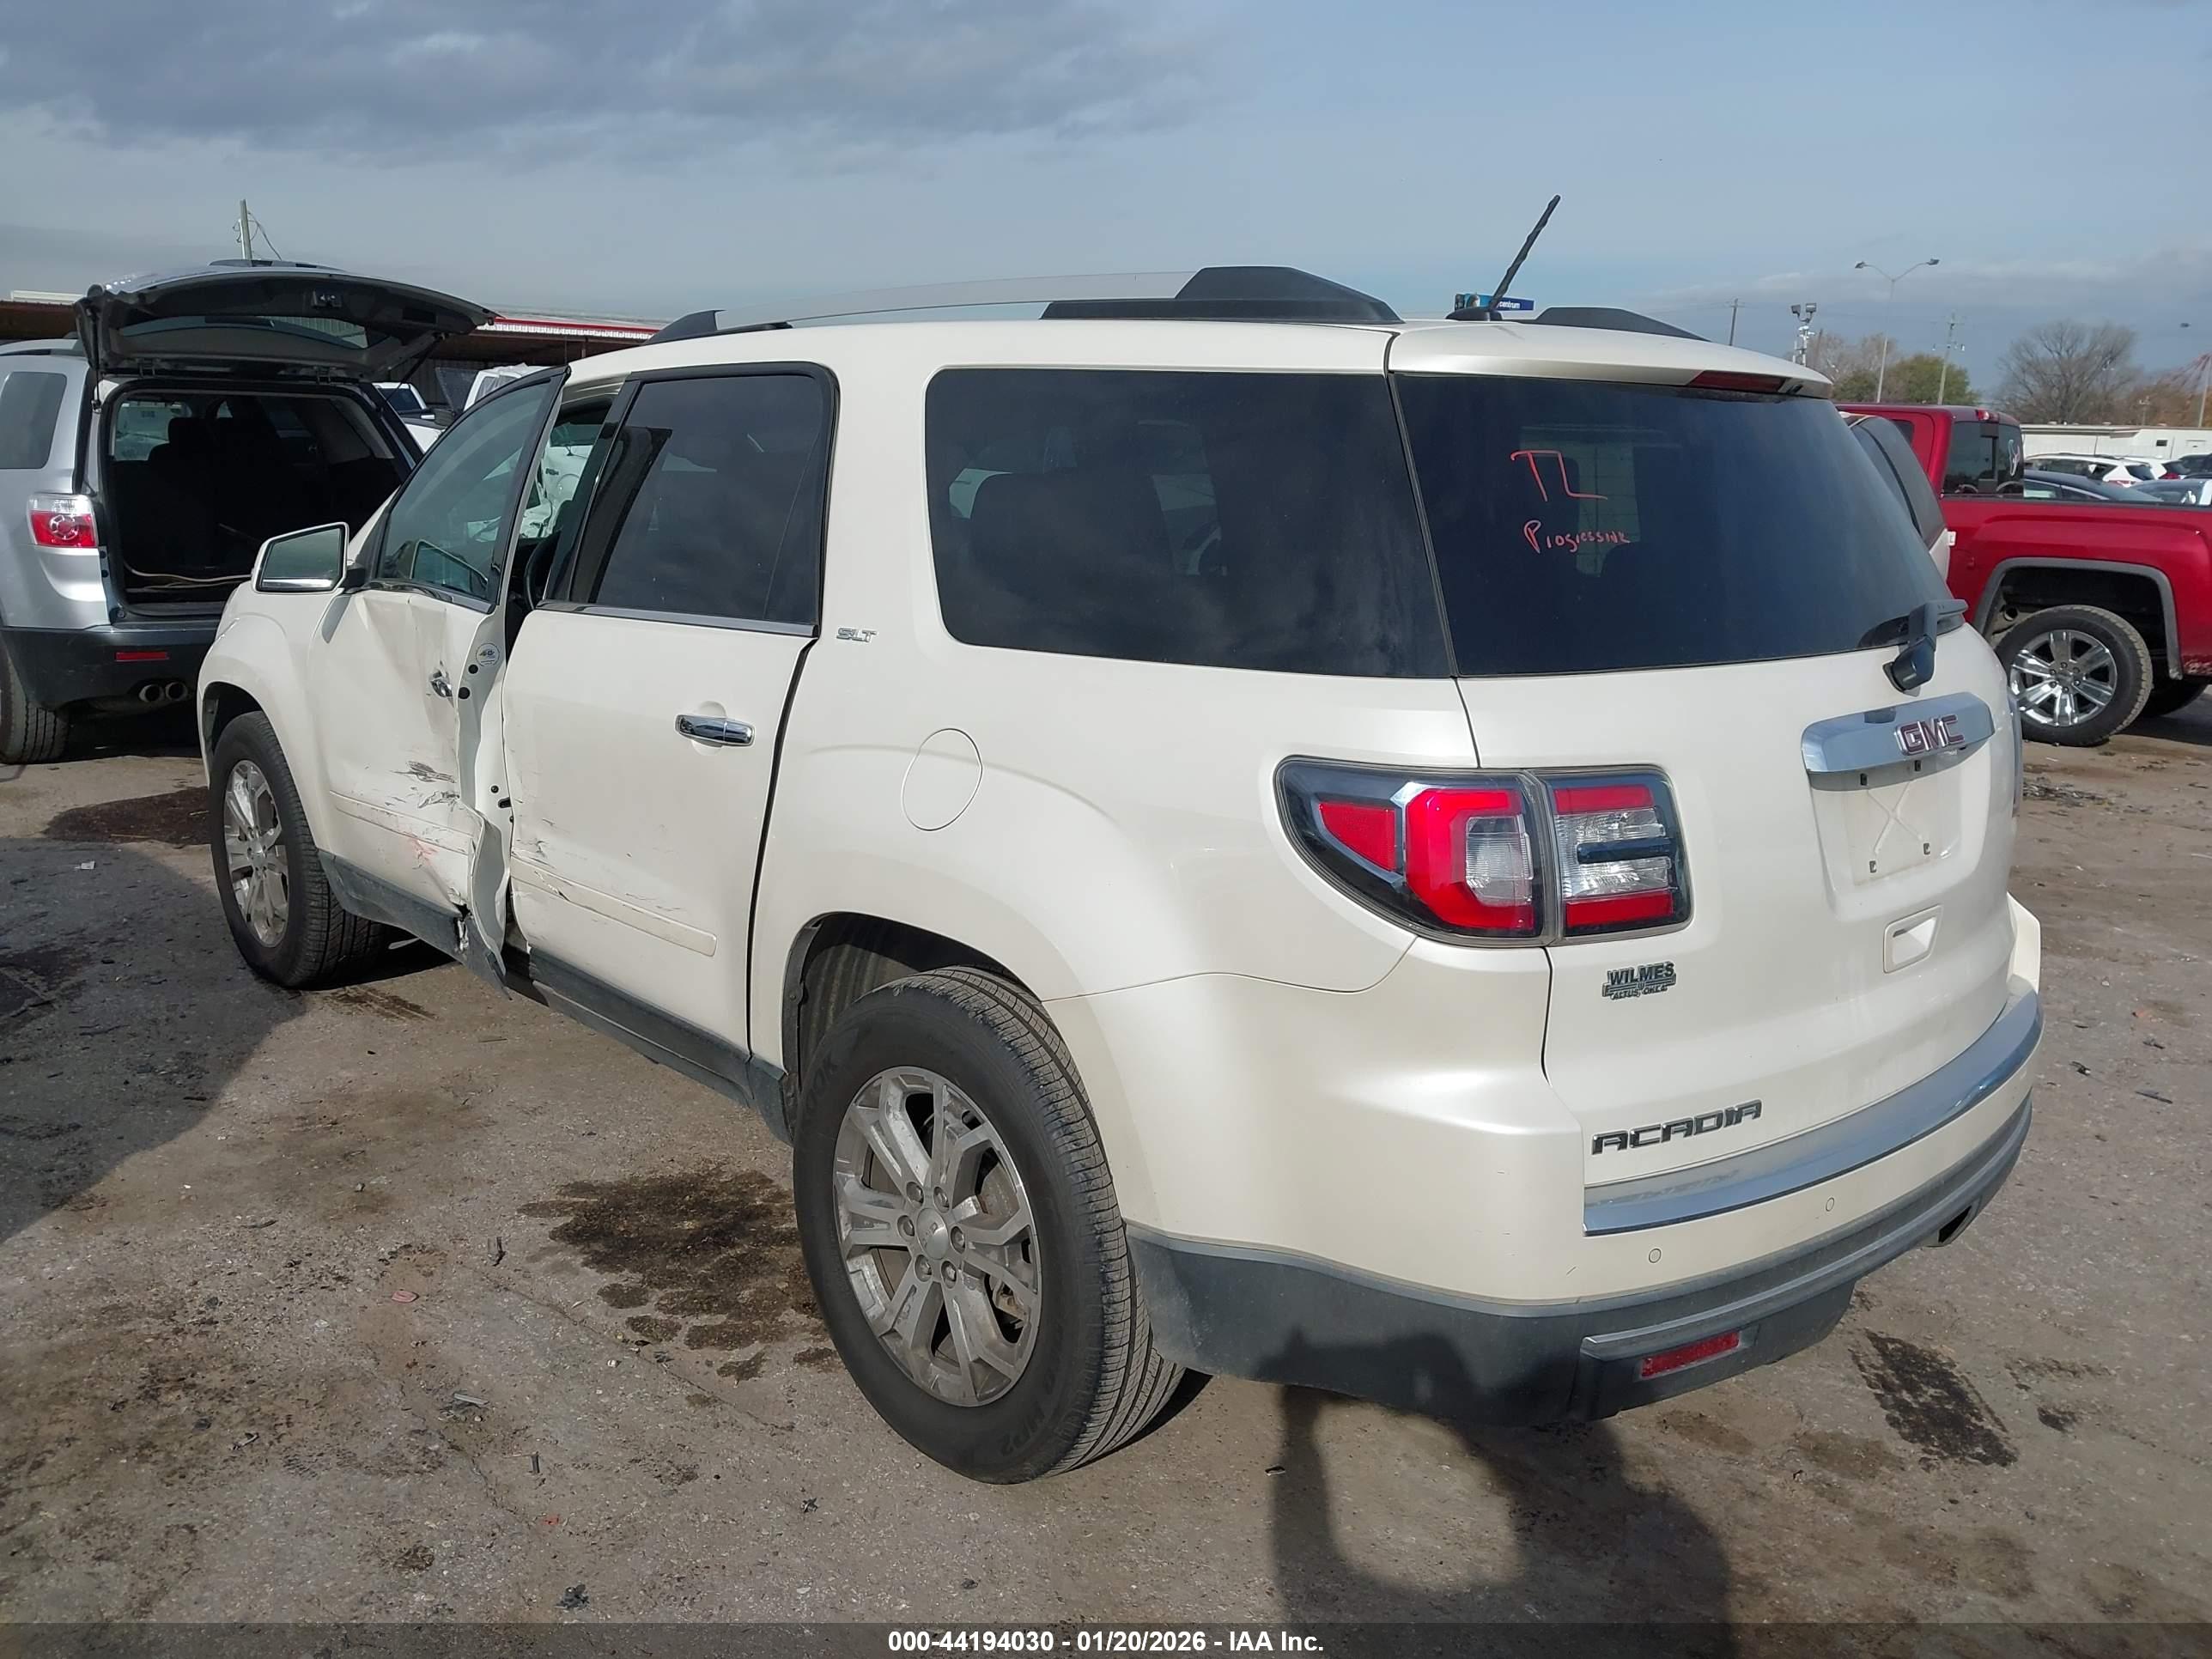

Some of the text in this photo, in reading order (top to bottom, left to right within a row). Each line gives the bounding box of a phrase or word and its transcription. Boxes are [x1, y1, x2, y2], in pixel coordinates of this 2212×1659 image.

[1510, 449, 1608, 502] TL
[836, 627, 878, 642] SLT
[1894, 714, 1966, 757] GMC
[1607, 961, 1674, 986] WILMES
[1591, 1099, 1763, 1156] ACADIA
